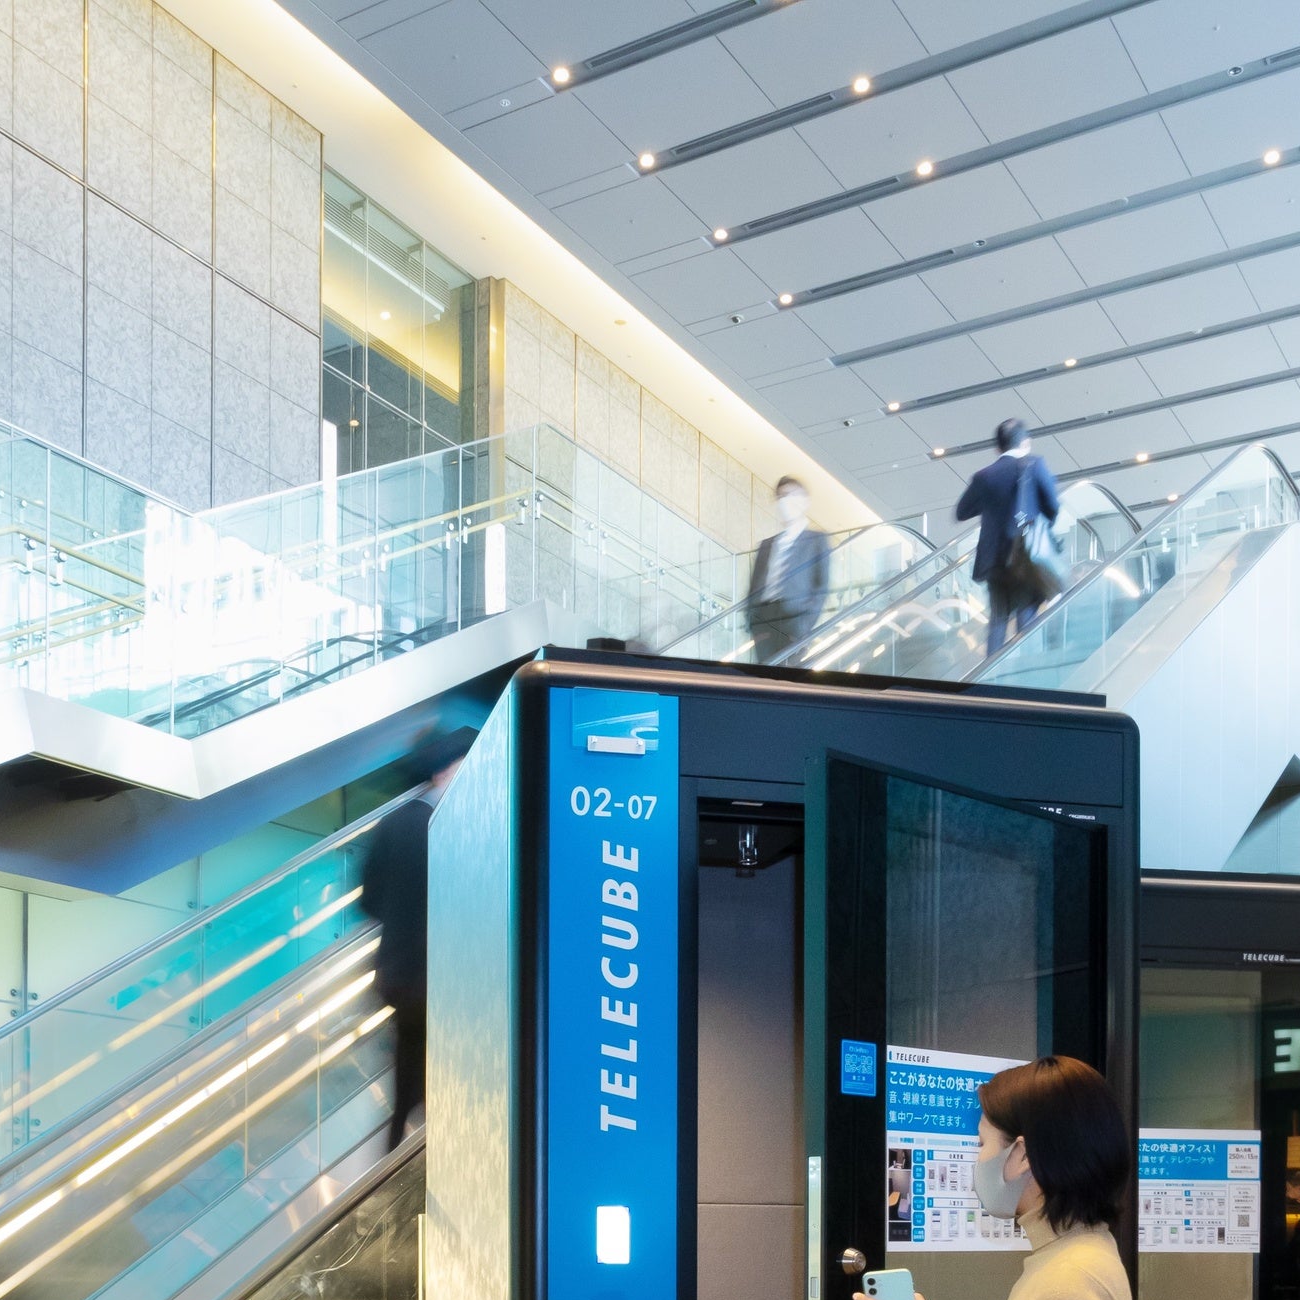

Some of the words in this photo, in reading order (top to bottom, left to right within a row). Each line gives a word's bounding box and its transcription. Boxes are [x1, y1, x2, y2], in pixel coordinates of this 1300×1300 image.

[569, 784, 658, 822] 02-07
[1242, 952, 1286, 962] TELECUBE
[600, 839, 640, 1133] TELECUBE
[896, 1052, 931, 1064] TELECUBE
